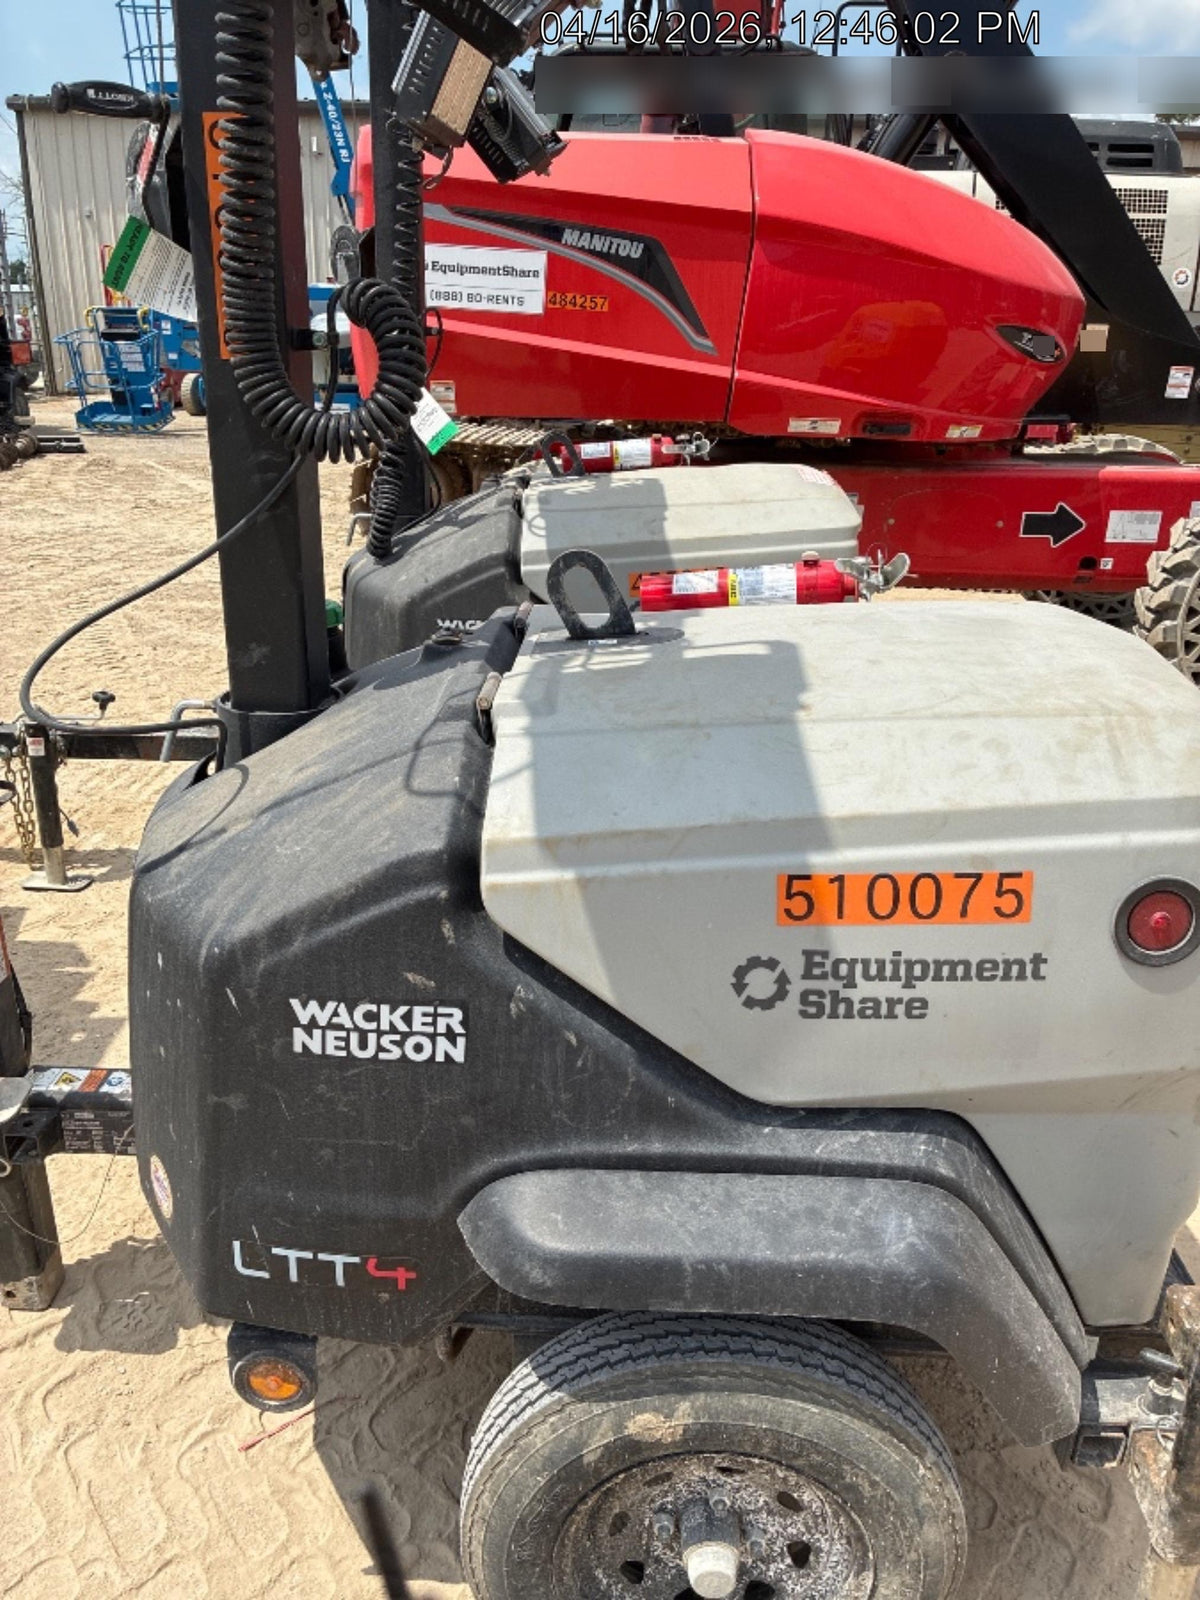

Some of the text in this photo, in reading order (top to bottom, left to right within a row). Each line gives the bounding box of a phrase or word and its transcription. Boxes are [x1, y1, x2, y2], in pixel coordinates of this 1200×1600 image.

[561, 228, 645, 259] MANITOU
[431, 260, 540, 279] EquipmentShare
[548, 292, 608, 311] 484257
[782, 872, 1026, 922] 510075
[800, 949, 1048, 989] Equipment
[289, 997, 466, 1035] WACKER
[799, 988, 930, 1020] Share
[292, 1026, 467, 1064] NEUSON
[232, 1240, 417, 1291] LTT4
